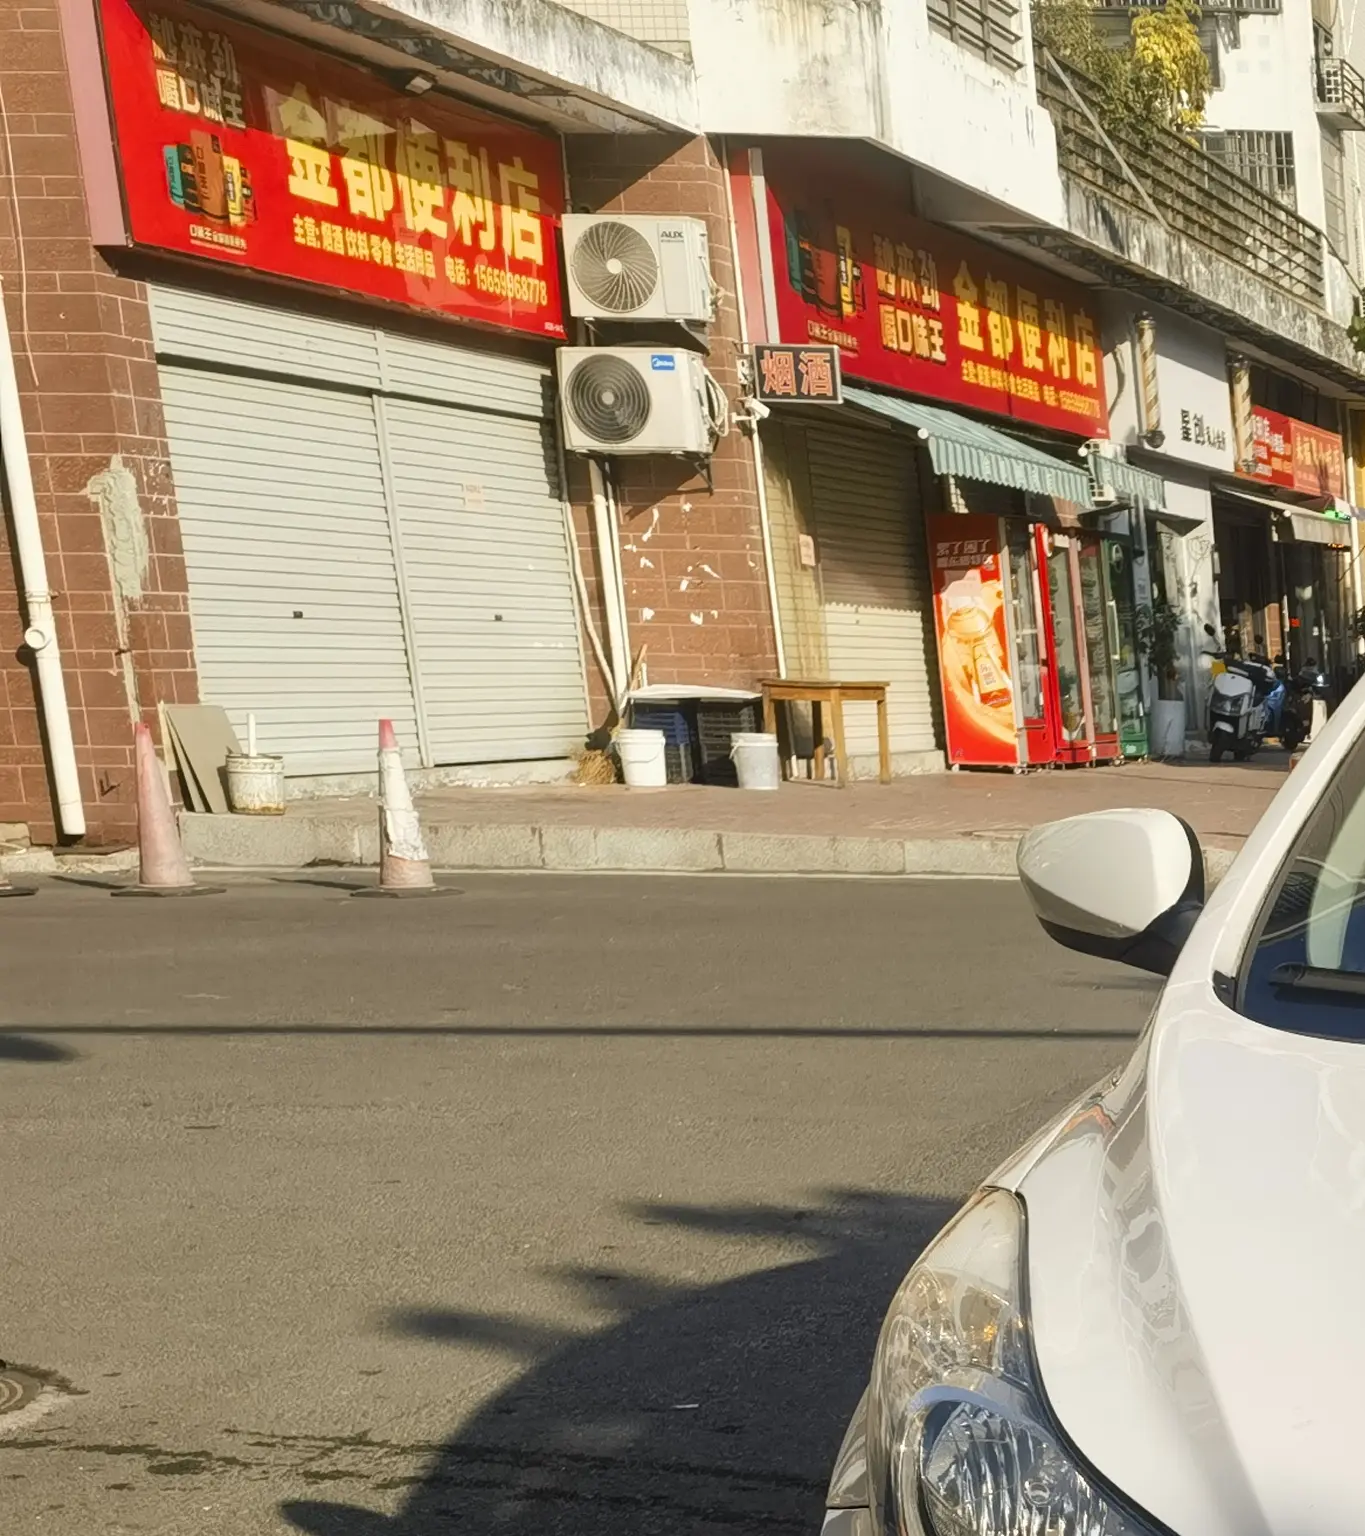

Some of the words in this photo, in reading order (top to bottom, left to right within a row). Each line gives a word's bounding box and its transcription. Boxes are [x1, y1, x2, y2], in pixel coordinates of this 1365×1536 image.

[279, 82, 544, 266] 金都便利店
[370, 234, 393, 267] 零食
[661, 230, 684, 239] AUX
[953, 259, 1097, 388] 金都便利店
[760, 350, 833, 396] 烟酒
